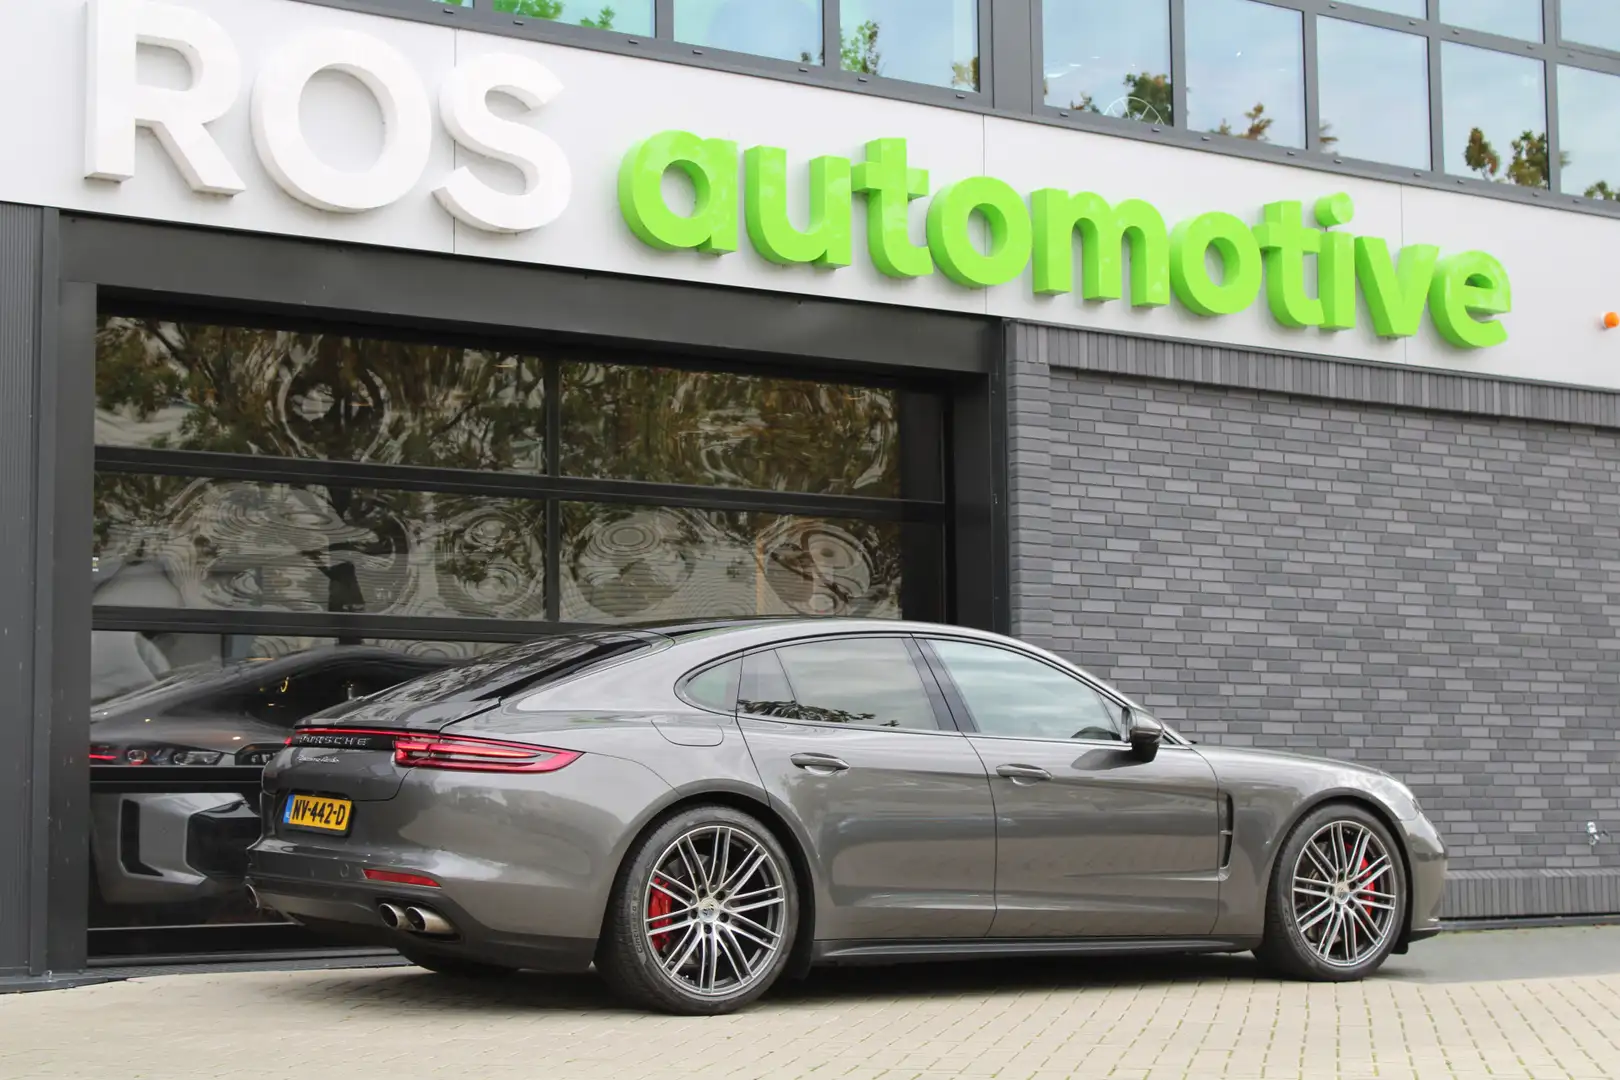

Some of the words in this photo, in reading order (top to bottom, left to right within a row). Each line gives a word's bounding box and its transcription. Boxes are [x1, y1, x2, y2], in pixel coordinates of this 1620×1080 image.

[84, 0, 572, 235] ROS
[618, 130, 1512, 349] automotive
[291, 799, 347, 827] NV-442-D
